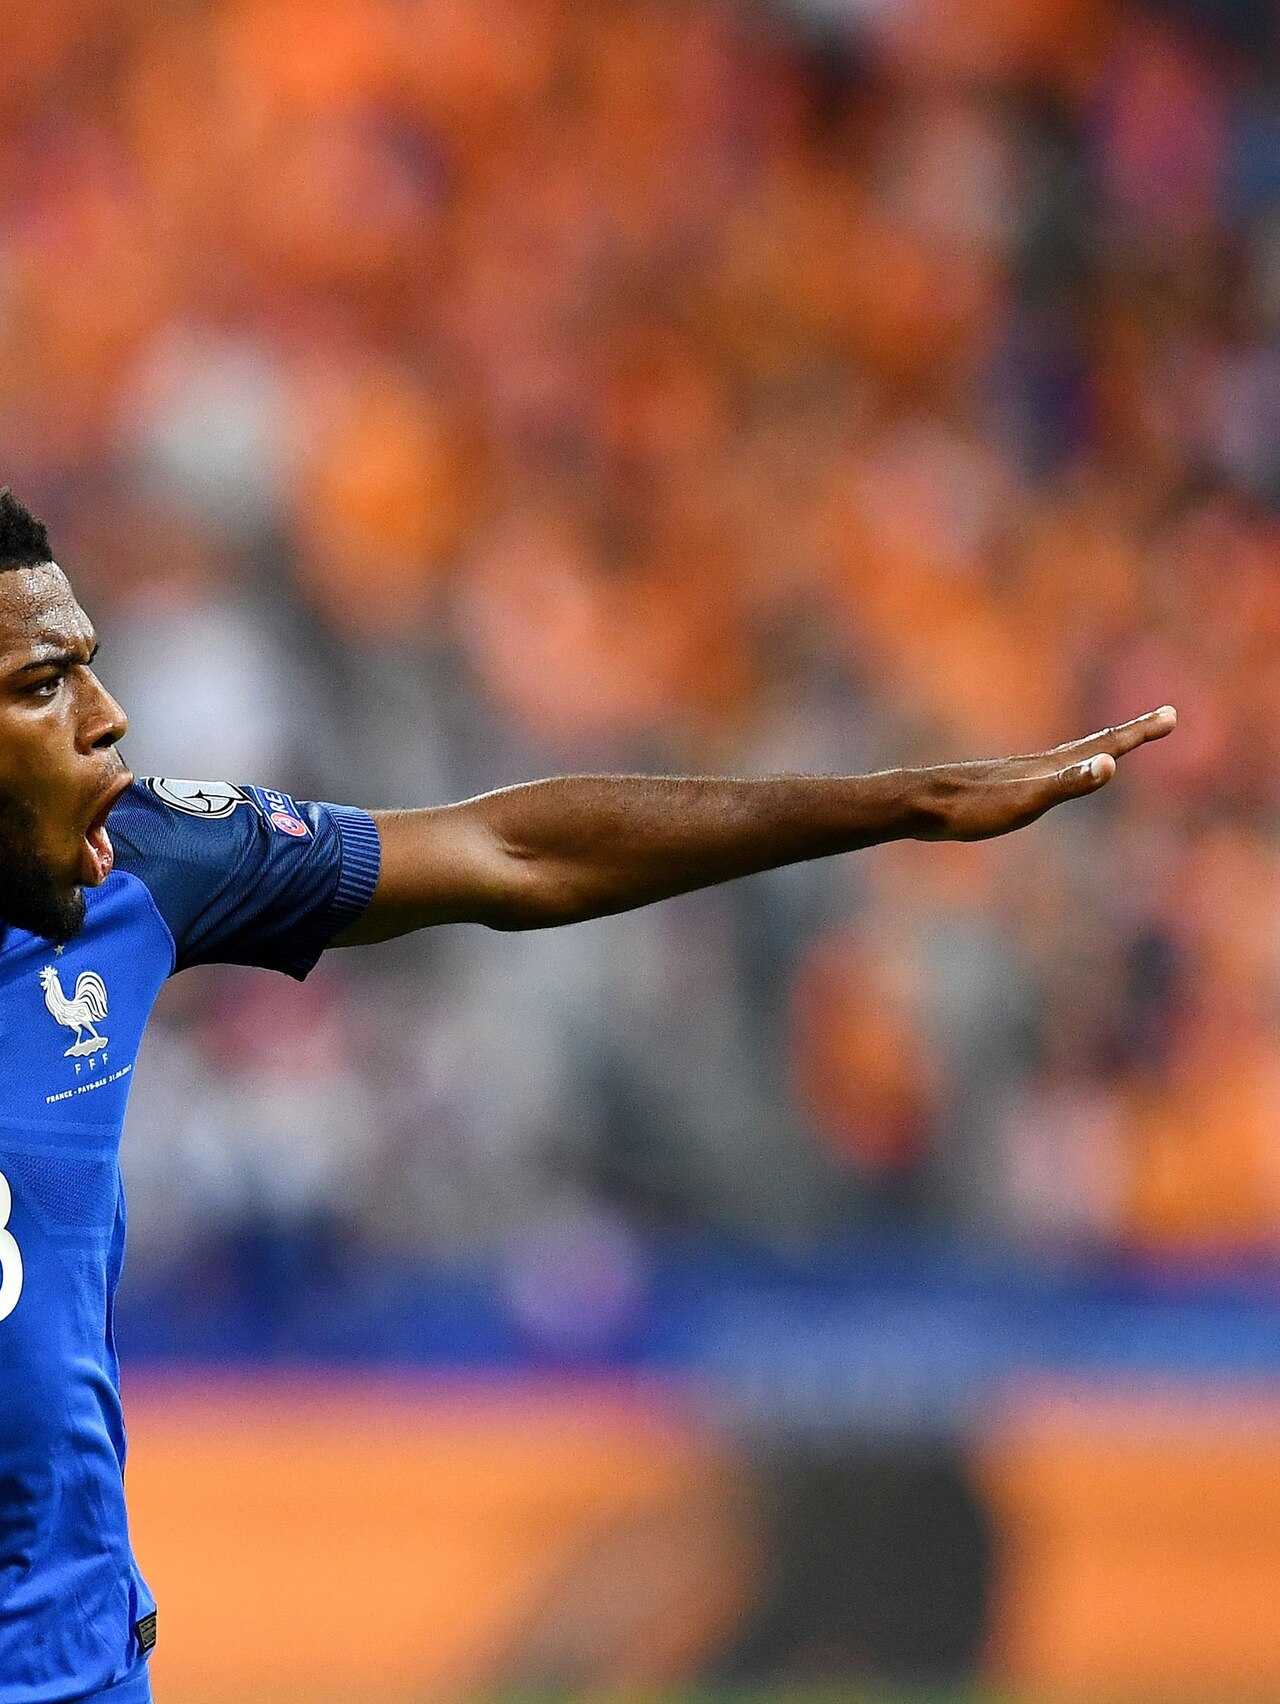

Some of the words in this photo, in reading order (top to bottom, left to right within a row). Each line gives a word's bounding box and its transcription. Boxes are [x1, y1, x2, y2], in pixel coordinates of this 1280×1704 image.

[264, 792, 288, 814] RE
[46, 1090, 73, 1104] FRANCE
[78, 1078, 107, 1094] PAYS-BAS
